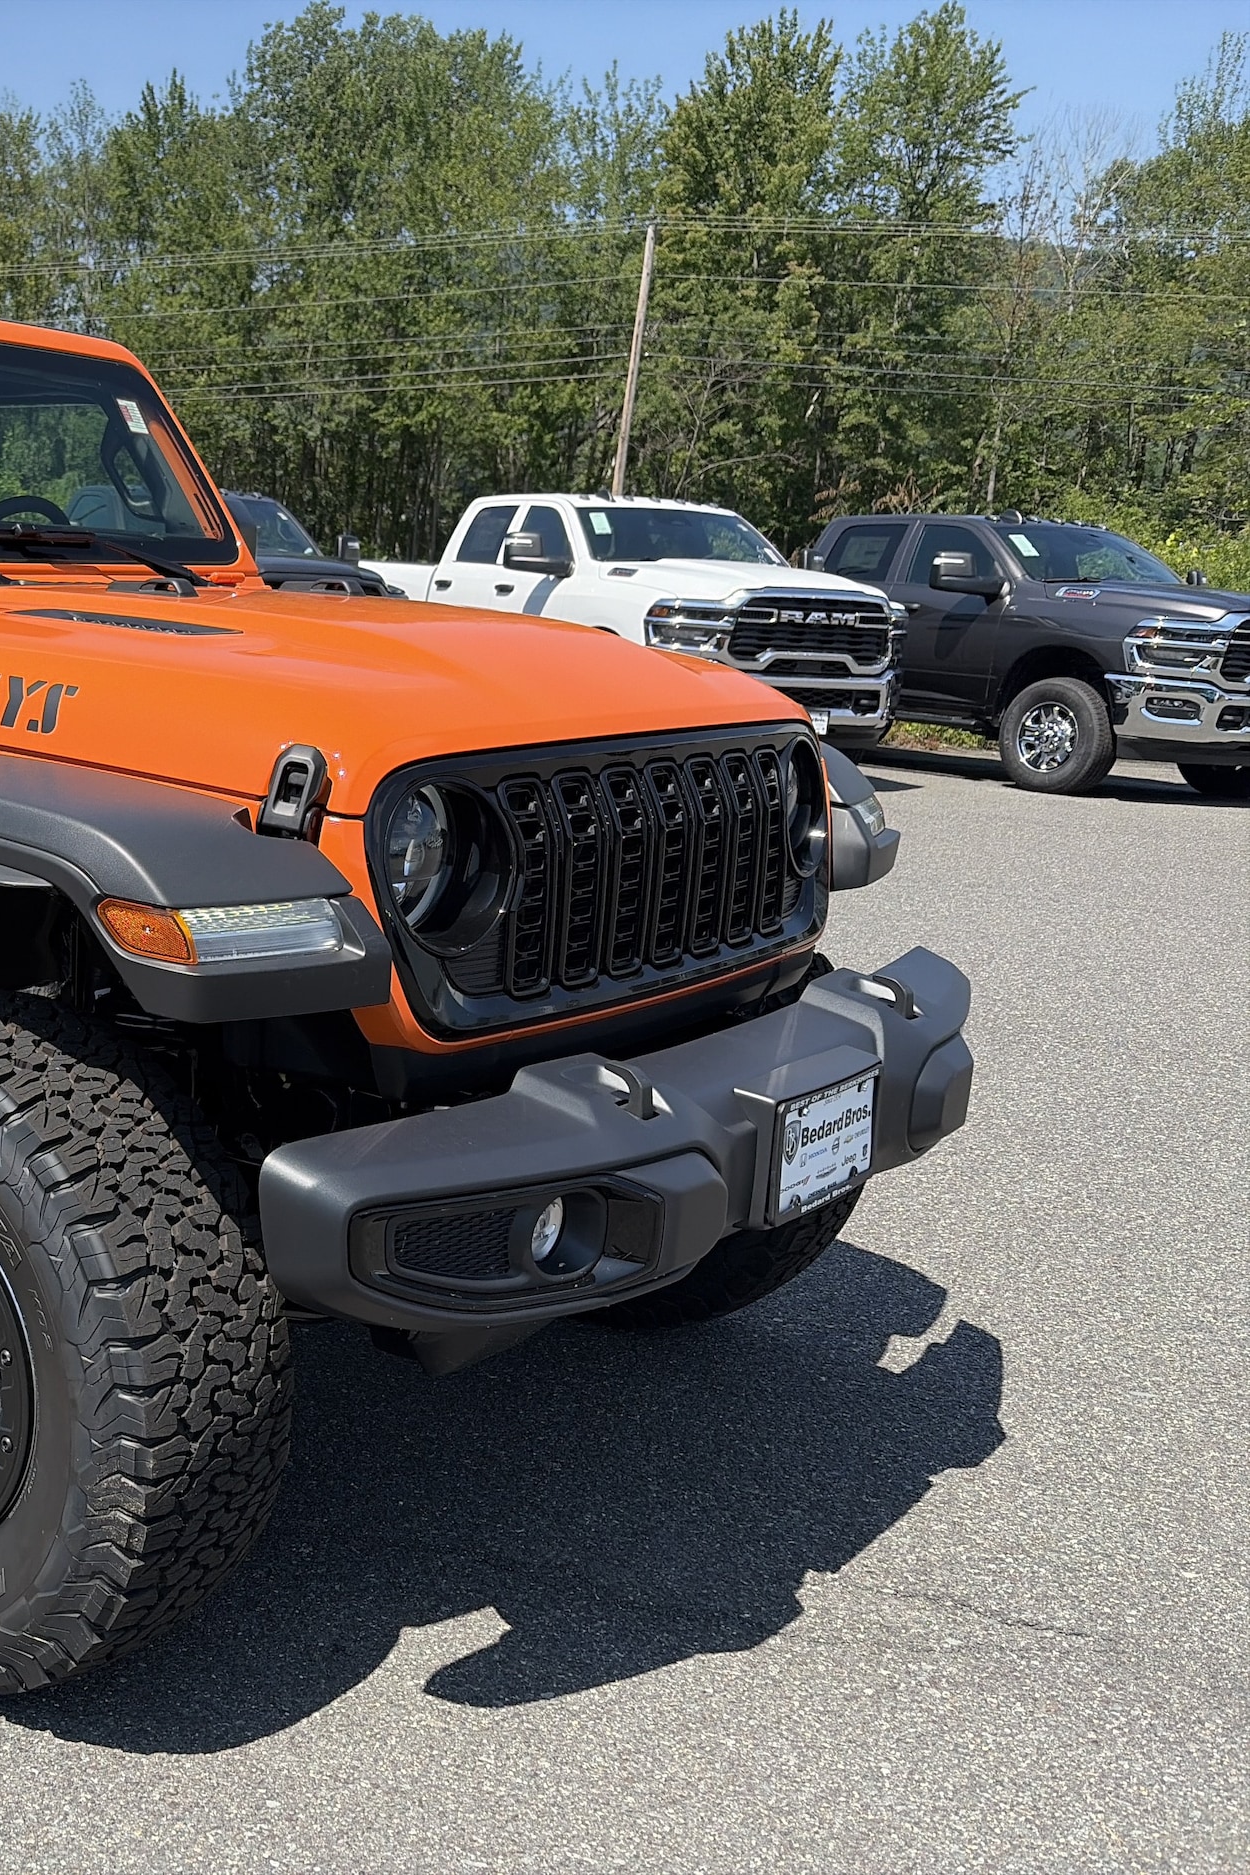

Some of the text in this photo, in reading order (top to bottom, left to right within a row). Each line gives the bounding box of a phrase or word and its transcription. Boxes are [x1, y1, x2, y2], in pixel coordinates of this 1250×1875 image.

[780, 610, 855, 626] RAM
[790, 1098, 811, 1111] BEST
[811, 1093, 823, 1103] OF
[823, 1087, 839, 1098] THE
[801, 1103, 871, 1148] Bedard Bros.
[841, 1153, 857, 1167] Jeep
[800, 1185, 853, 1214] Bedard Bros.
